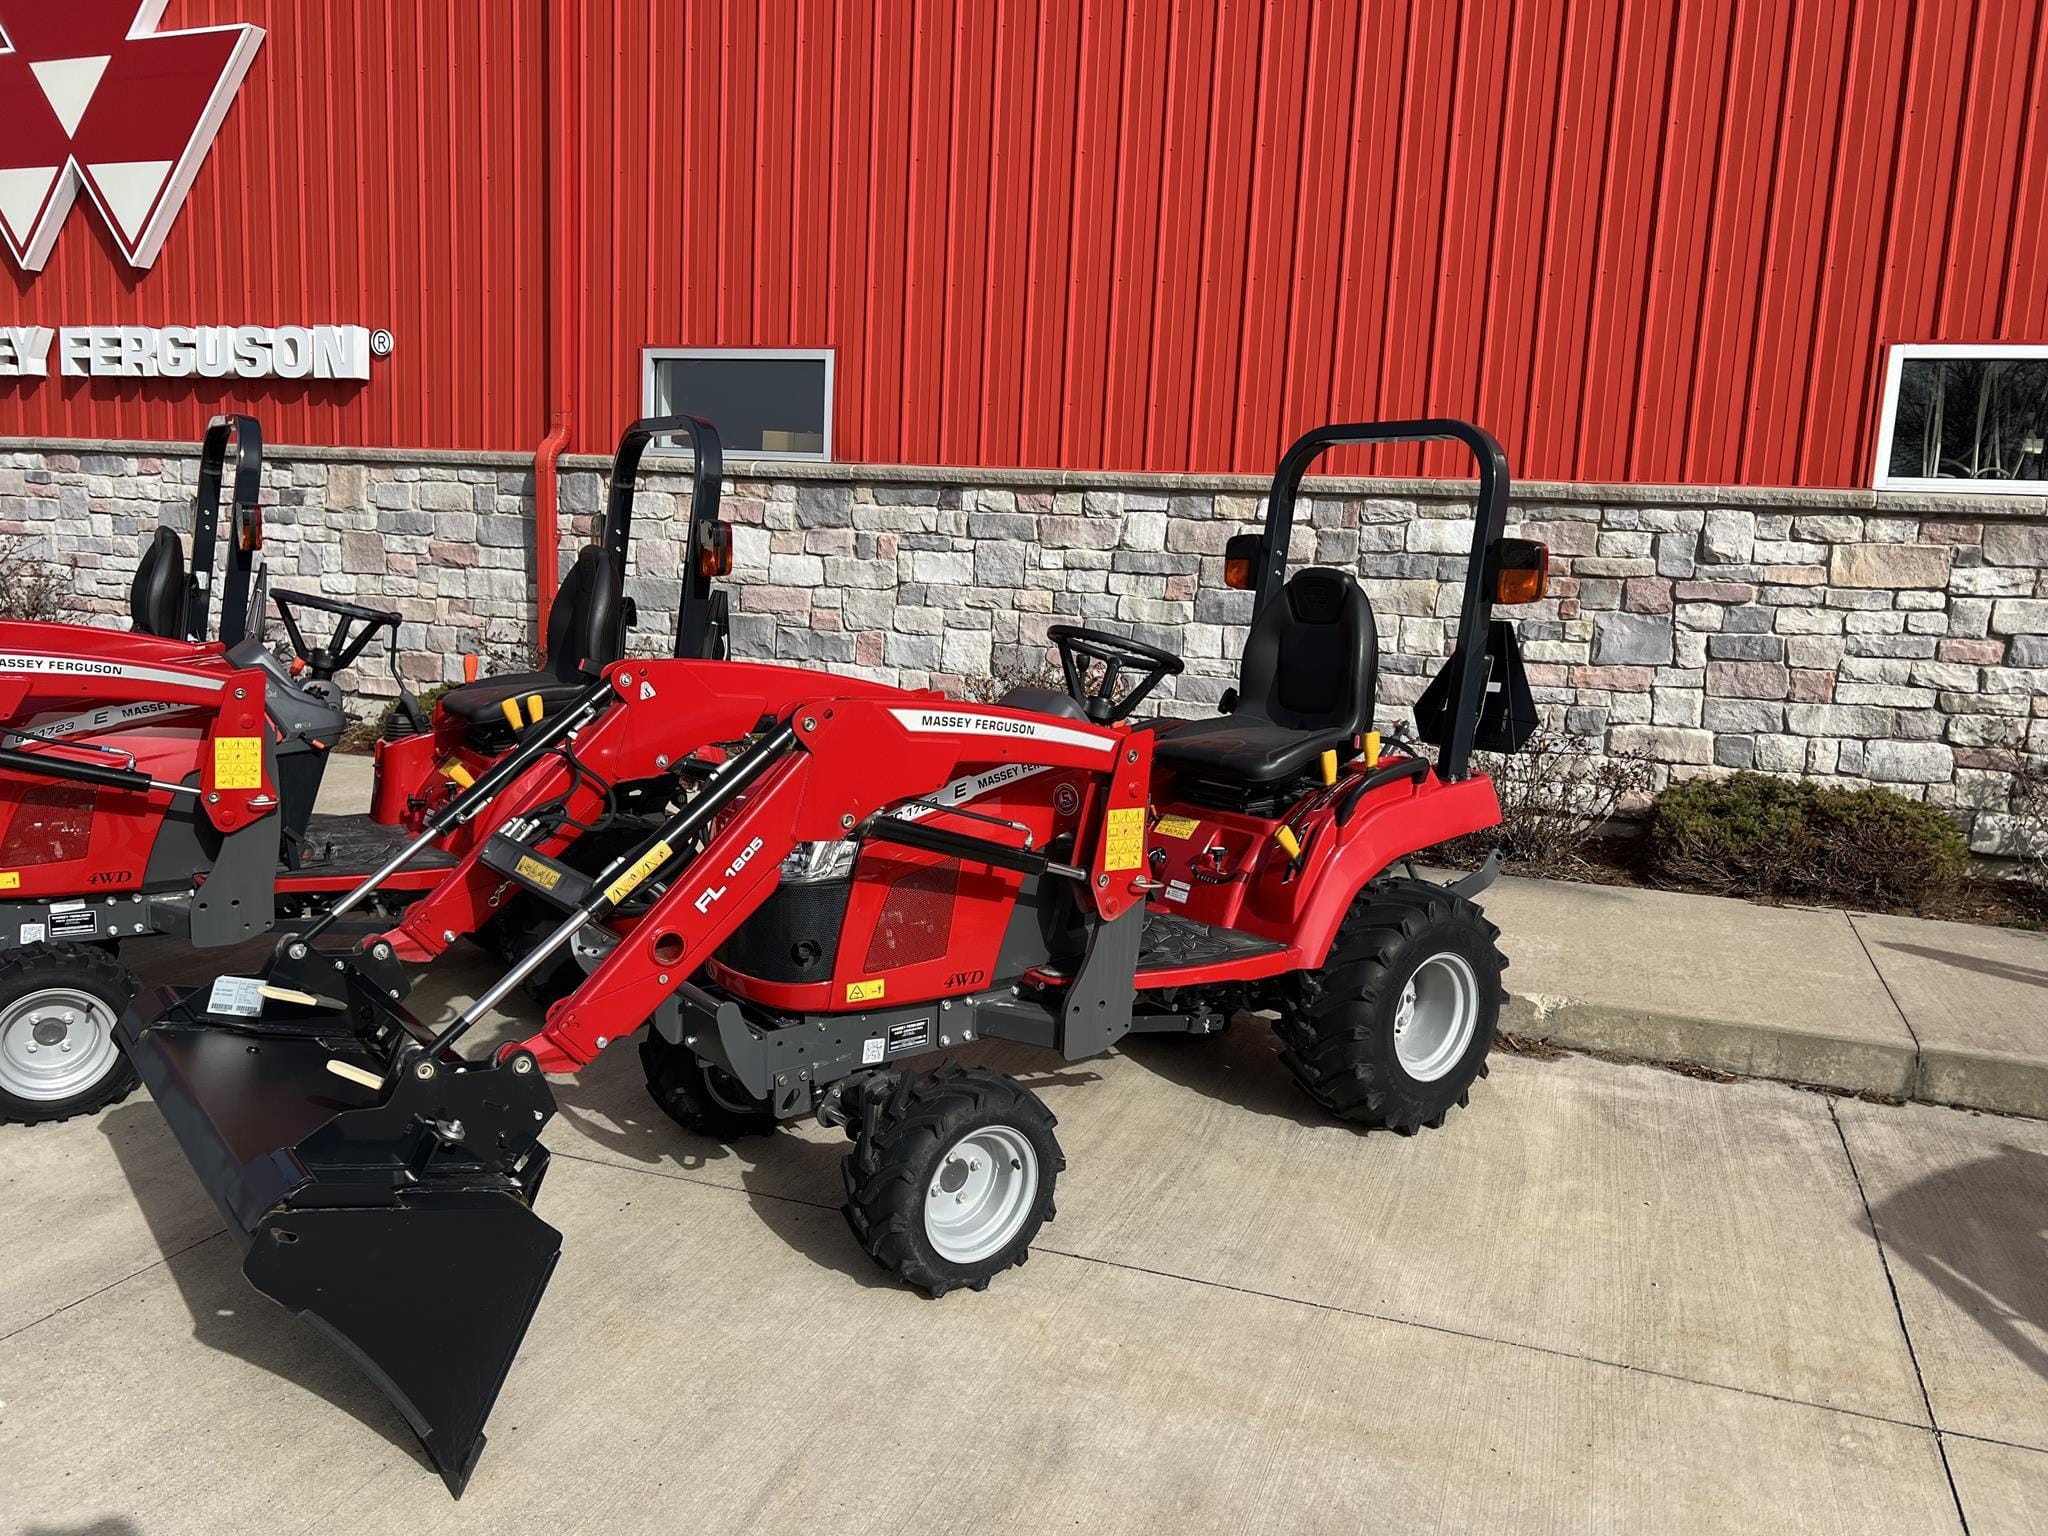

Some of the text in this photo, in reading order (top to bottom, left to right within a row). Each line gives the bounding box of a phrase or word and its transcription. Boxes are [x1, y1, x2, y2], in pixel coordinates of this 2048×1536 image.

[60, 324, 370, 379] FERGUSON
[49, 660, 122, 675] FERGUSON
[39, 721, 74, 736] 1723
[94, 711, 109, 725] E
[121, 702, 171, 718] MASSEY
[922, 715, 1035, 735] MASSEY FERGUSON
[954, 783, 967, 799] E
[977, 766, 1018, 788] MASSEY
[87, 870, 132, 885] 4WD
[694, 836, 764, 914] FL 1805
[944, 970, 984, 988] 4WD
